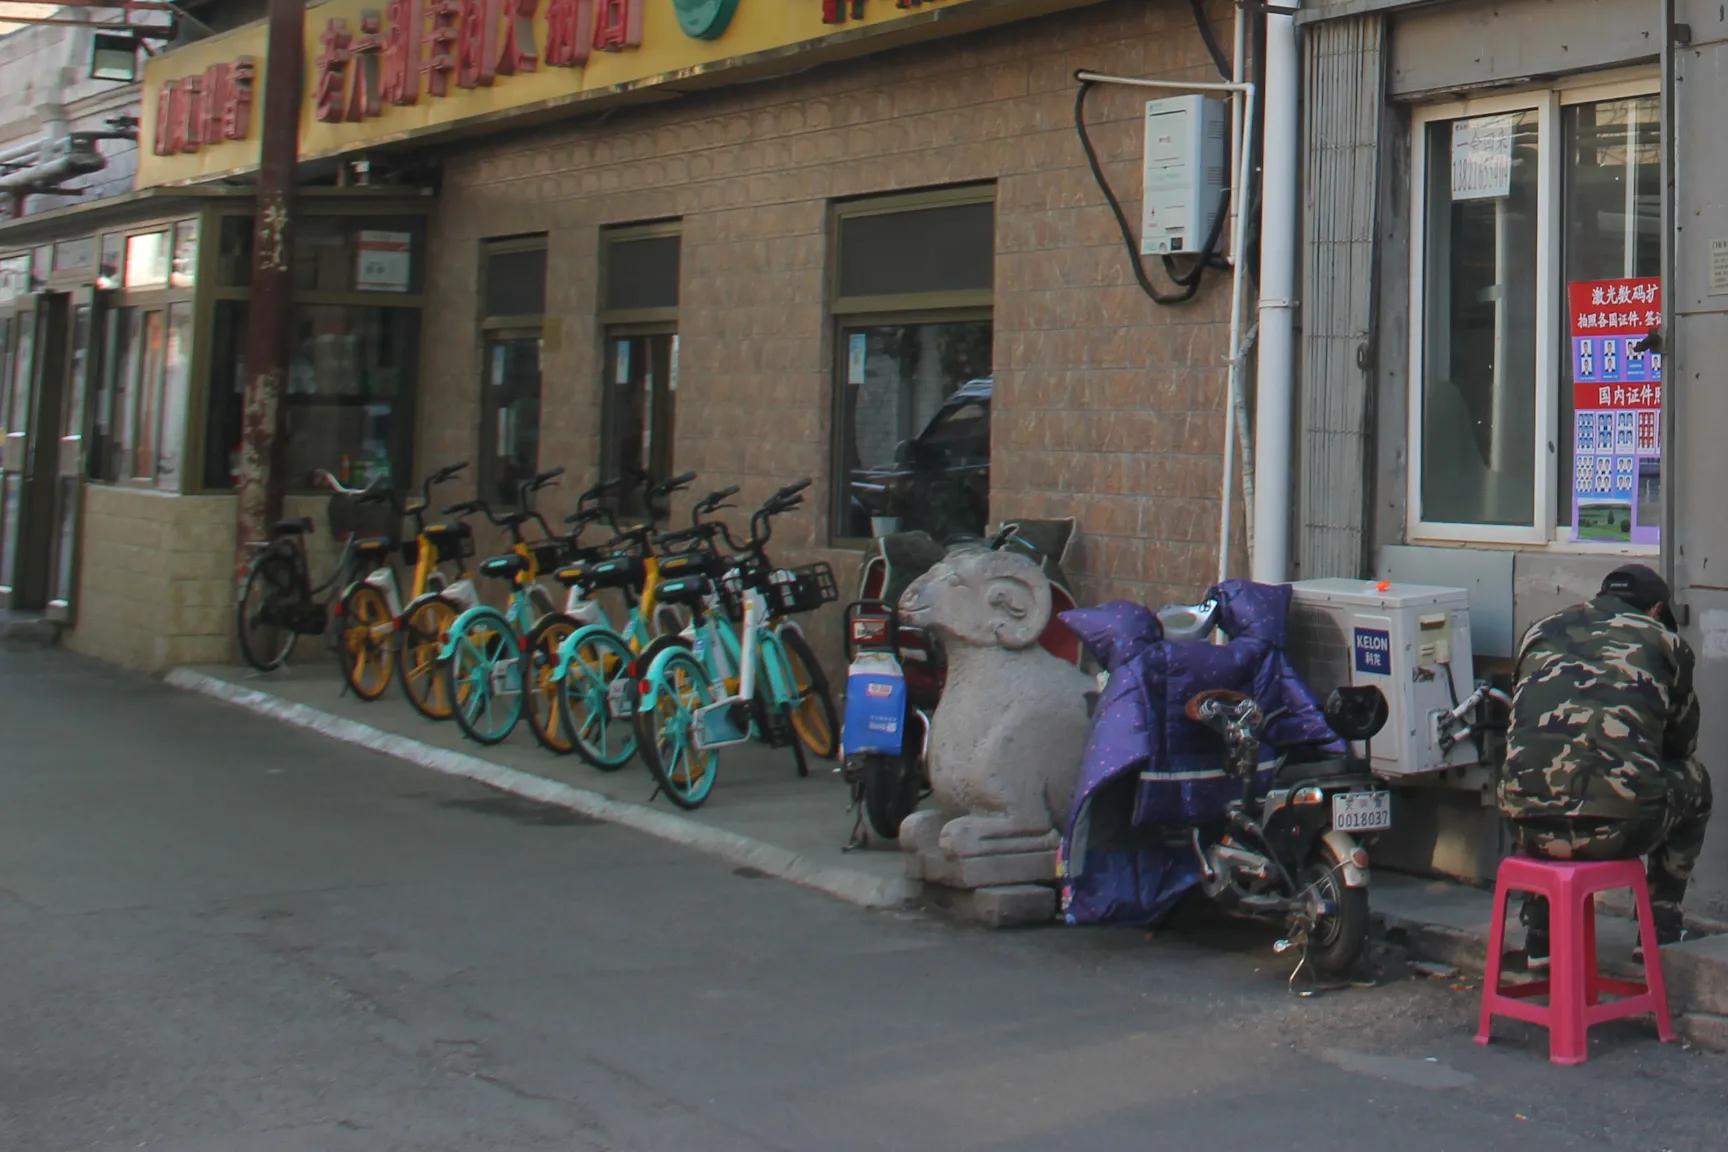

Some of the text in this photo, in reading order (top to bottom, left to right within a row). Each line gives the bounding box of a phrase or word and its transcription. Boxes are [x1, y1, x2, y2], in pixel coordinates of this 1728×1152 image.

[1591, 283, 1659, 305] 激光数码扩
[1356, 634, 1388, 652] KELON
[1337, 810, 1388, 828] 0018037
